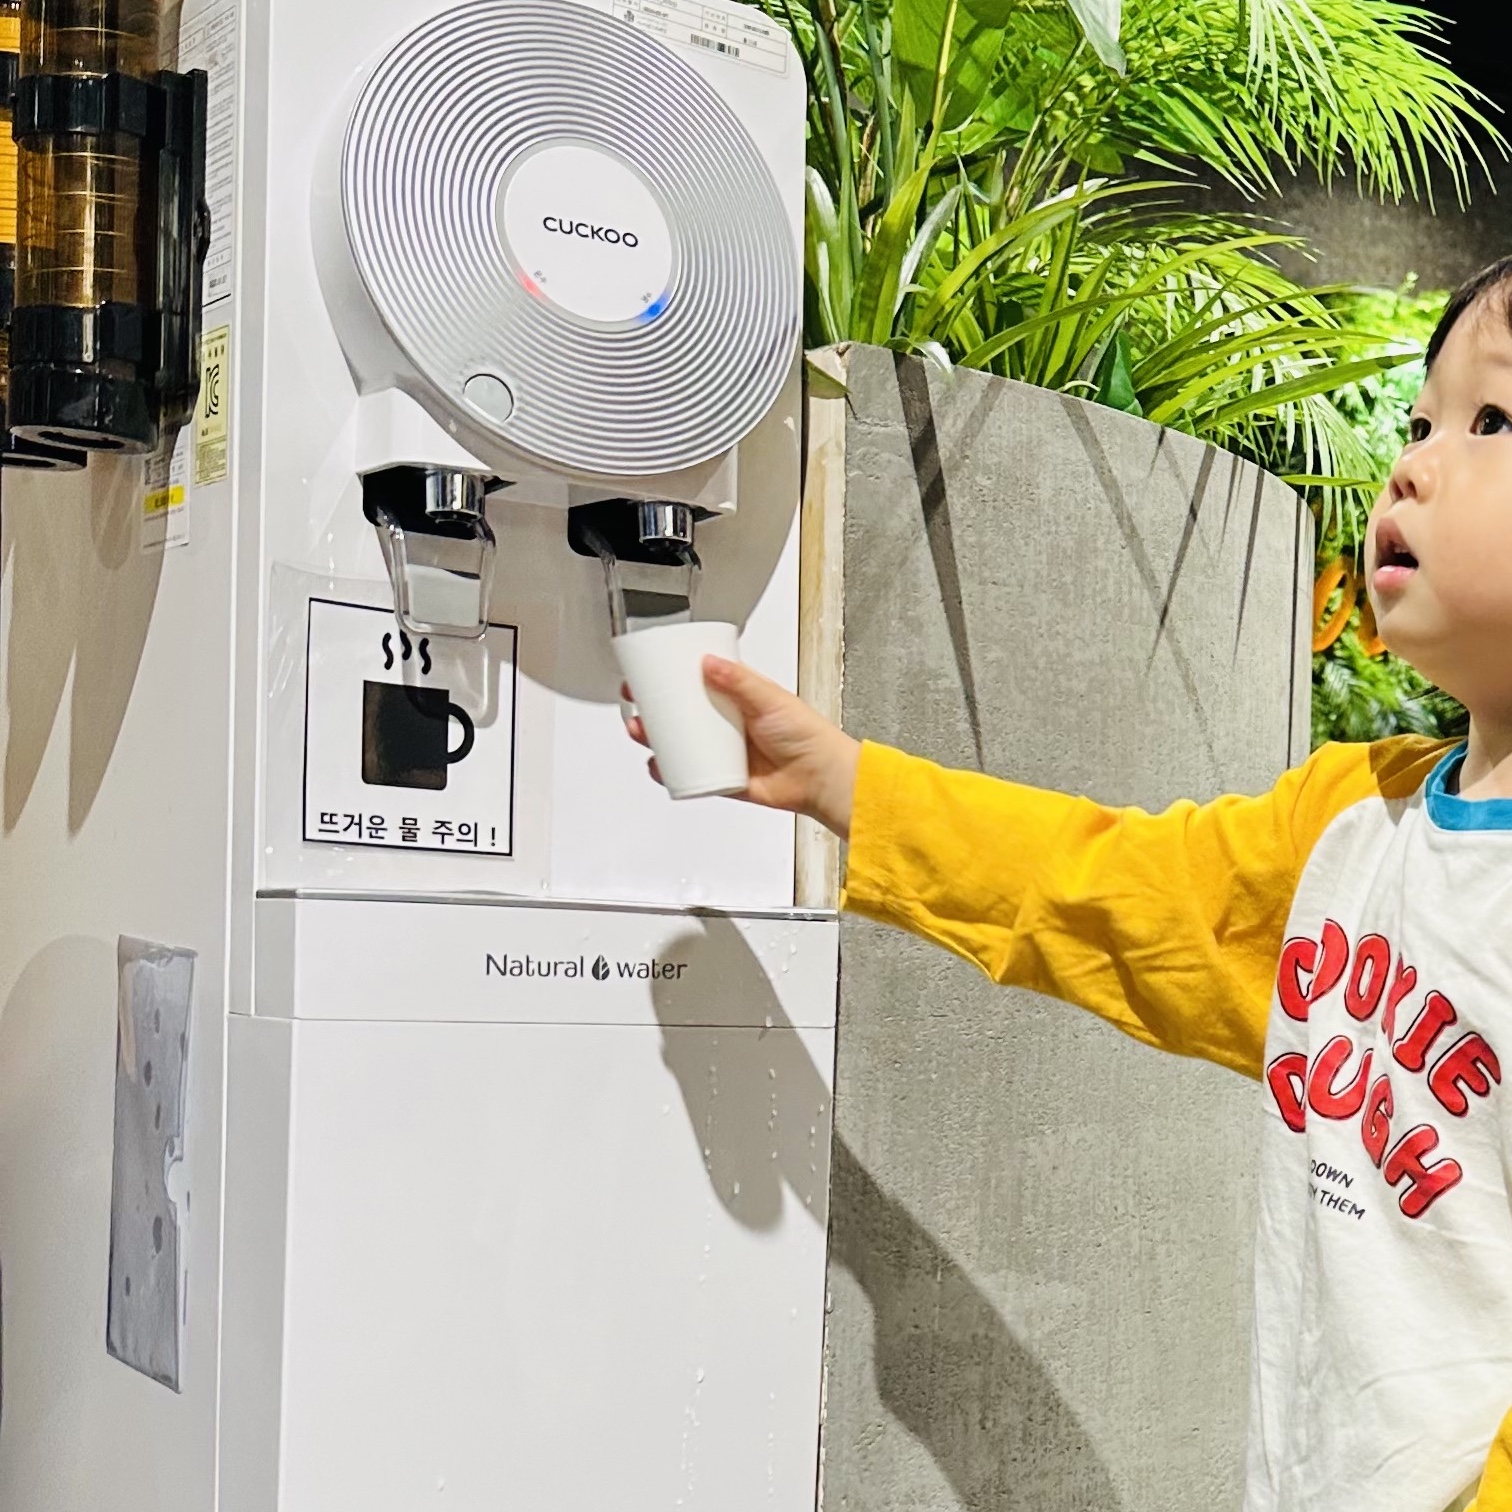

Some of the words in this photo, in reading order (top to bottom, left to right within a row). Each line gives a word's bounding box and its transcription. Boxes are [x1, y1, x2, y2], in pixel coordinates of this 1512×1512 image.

[543, 217, 639, 248] CUCKOO
[318, 812, 388, 839] 뜨거운
[399, 817, 421, 843] 물
[431, 820, 478, 847] 주의
[486, 953, 584, 978] Natural
[616, 958, 688, 980] water
[1320, 1189, 1366, 1220] THEM
